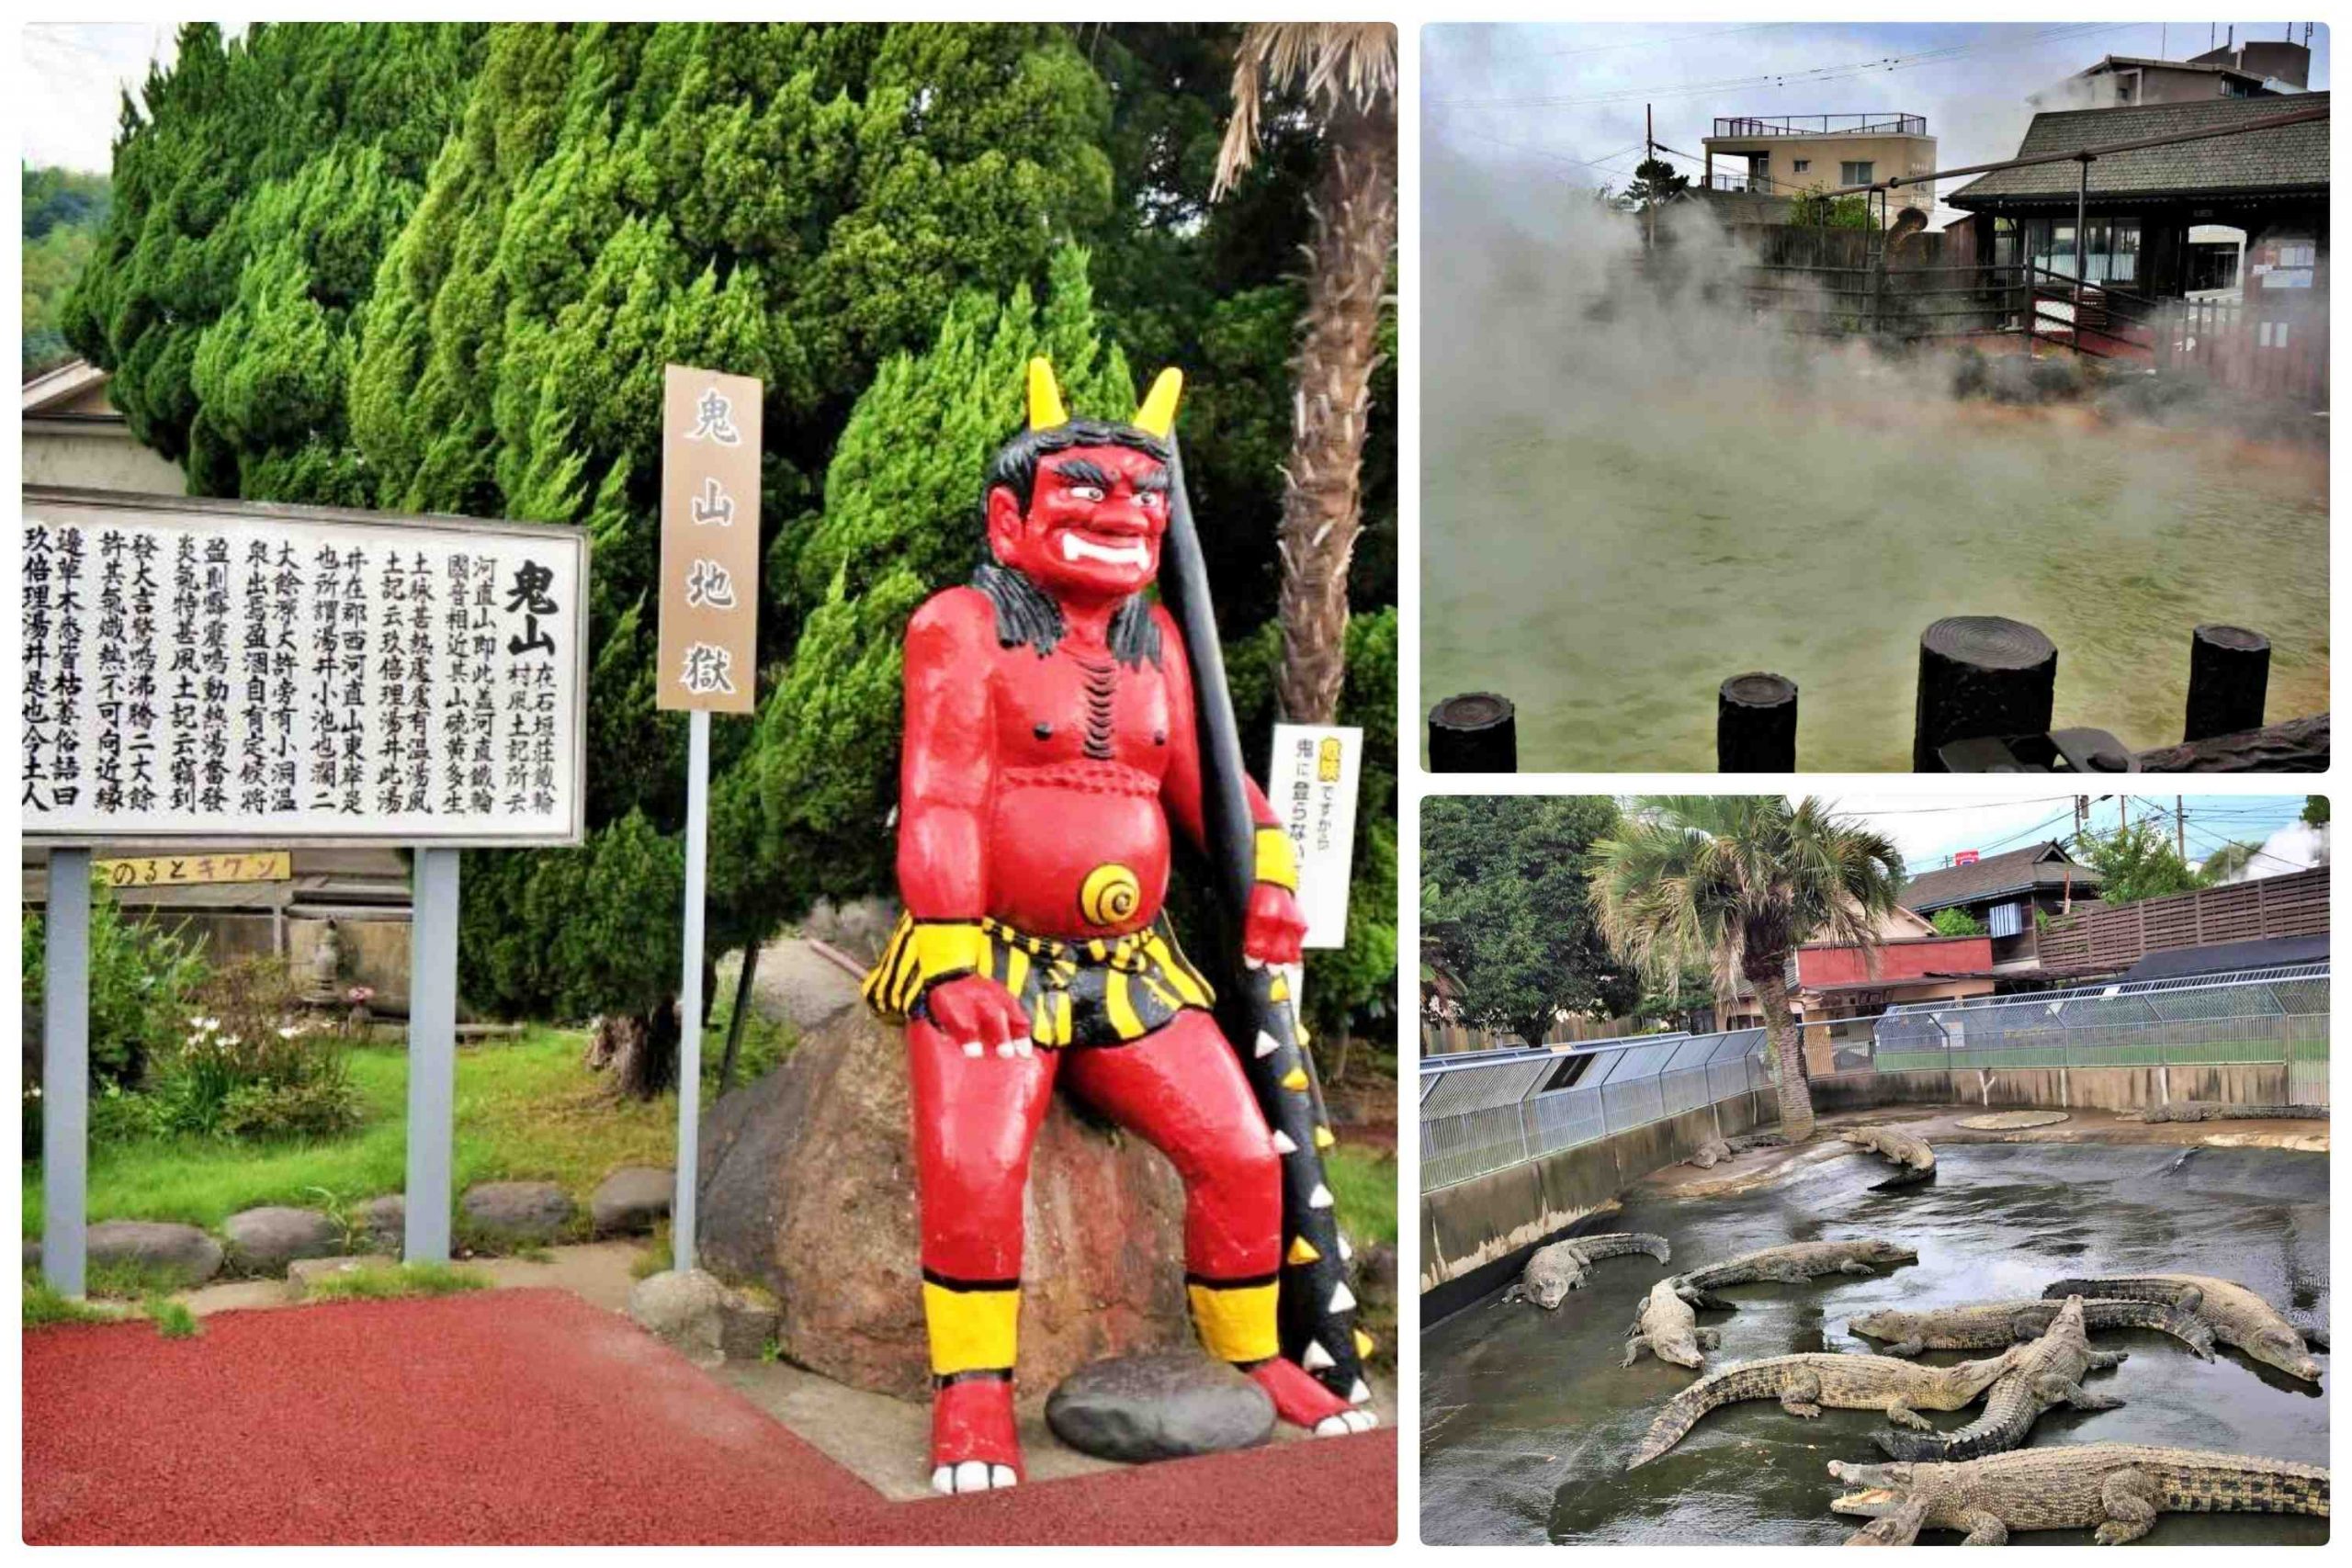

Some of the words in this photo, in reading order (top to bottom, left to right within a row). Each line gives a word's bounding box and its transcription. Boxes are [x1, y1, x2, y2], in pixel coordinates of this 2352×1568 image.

[505, 559, 559, 656] 鬼山
[682, 389, 740, 693] 鬼山地獄
